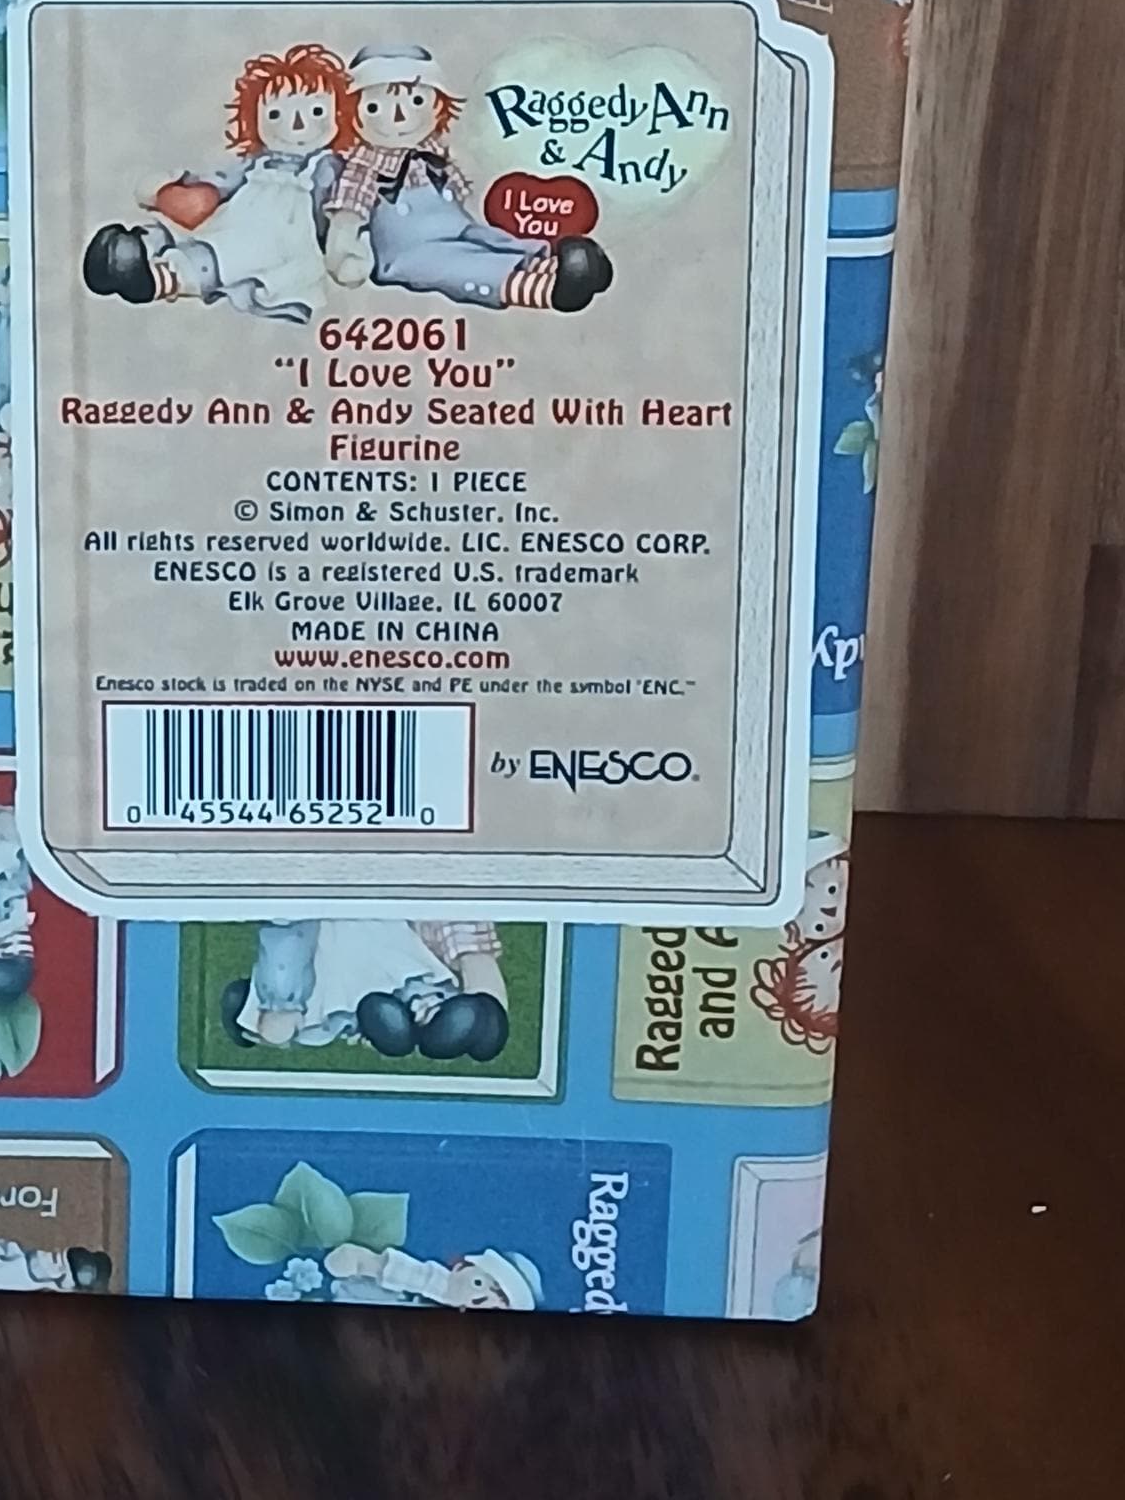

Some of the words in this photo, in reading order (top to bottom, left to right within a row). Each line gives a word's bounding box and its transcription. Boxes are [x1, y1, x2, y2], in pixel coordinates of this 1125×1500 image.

[485, 82, 648, 139] Raggedy
[646, 82, 729, 135] Ann
[540, 139, 566, 165] &
[572, 127, 687, 193] Andy
[504, 189, 512, 210] I
[519, 190, 574, 215] Love
[514, 212, 559, 236] You
[319, 317, 466, 351] 642061
[328, 358, 412, 388] Love
[61, 397, 193, 425] Raggedy
[207, 398, 270, 424] Ann
[286, 398, 315, 424] &
[331, 398, 413, 425] Andy
[427, 398, 535, 425] Seated
[552, 398, 624, 425] With
[642, 398, 732, 426] Heart
[330, 434, 460, 461] Figurine
[266, 471, 418, 492] CONTENTS:
[453, 471, 527, 492] PIECE
[269, 501, 344, 521] Simon
[355, 501, 377, 521] &
[515, 502, 560, 523] Inc.
[84, 531, 117, 551] All
[127, 531, 195, 551] rights
[206, 532, 309, 551] reserved
[321, 531, 451, 553] worldwide.
[462, 532, 510, 553] LIC.
[521, 533, 624, 554] ENESCO
[636, 533, 711, 555] CORP.
[154, 561, 257, 582] ENESCO
[268, 562, 287, 582] is
[297, 566, 311, 582] a
[322, 562, 442, 583] registered
[454, 562, 504, 583] U.S.
[516, 563, 639, 583] trademark
[228, 591, 265, 612] Elk
[275, 591, 345, 612] Grove
[454, 592, 476, 612] IL
[487, 592, 564, 613] 60007
[291, 621, 366, 641] MADE
[378, 621, 404, 642] IN
[416, 622, 499, 642] CHINA
[275, 650, 510, 670] www.enesco.com
[96, 675, 155, 692] Enesco
[161, 677, 206, 692] stock
[213, 677, 226, 692] is
[234, 677, 287, 692] traded
[295, 679, 316, 692] on
[323, 677, 349, 692] the
[356, 677, 405, 692] NYSE
[412, 677, 442, 693] and
[449, 678, 472, 693] PE
[479, 678, 529, 694] under
[537, 679, 563, 694] the
[570, 679, 631, 695] symbol
[490, 751, 521, 779] by
[127, 805, 142, 824] 0
[180, 802, 272, 824] 45544
[289, 802, 383, 825] 65252
[420, 807, 435, 825] 0
[636, 927, 686, 1071] Ragged
[692, 967, 737, 1039] and
[572, 1172, 629, 1315] Ragged
